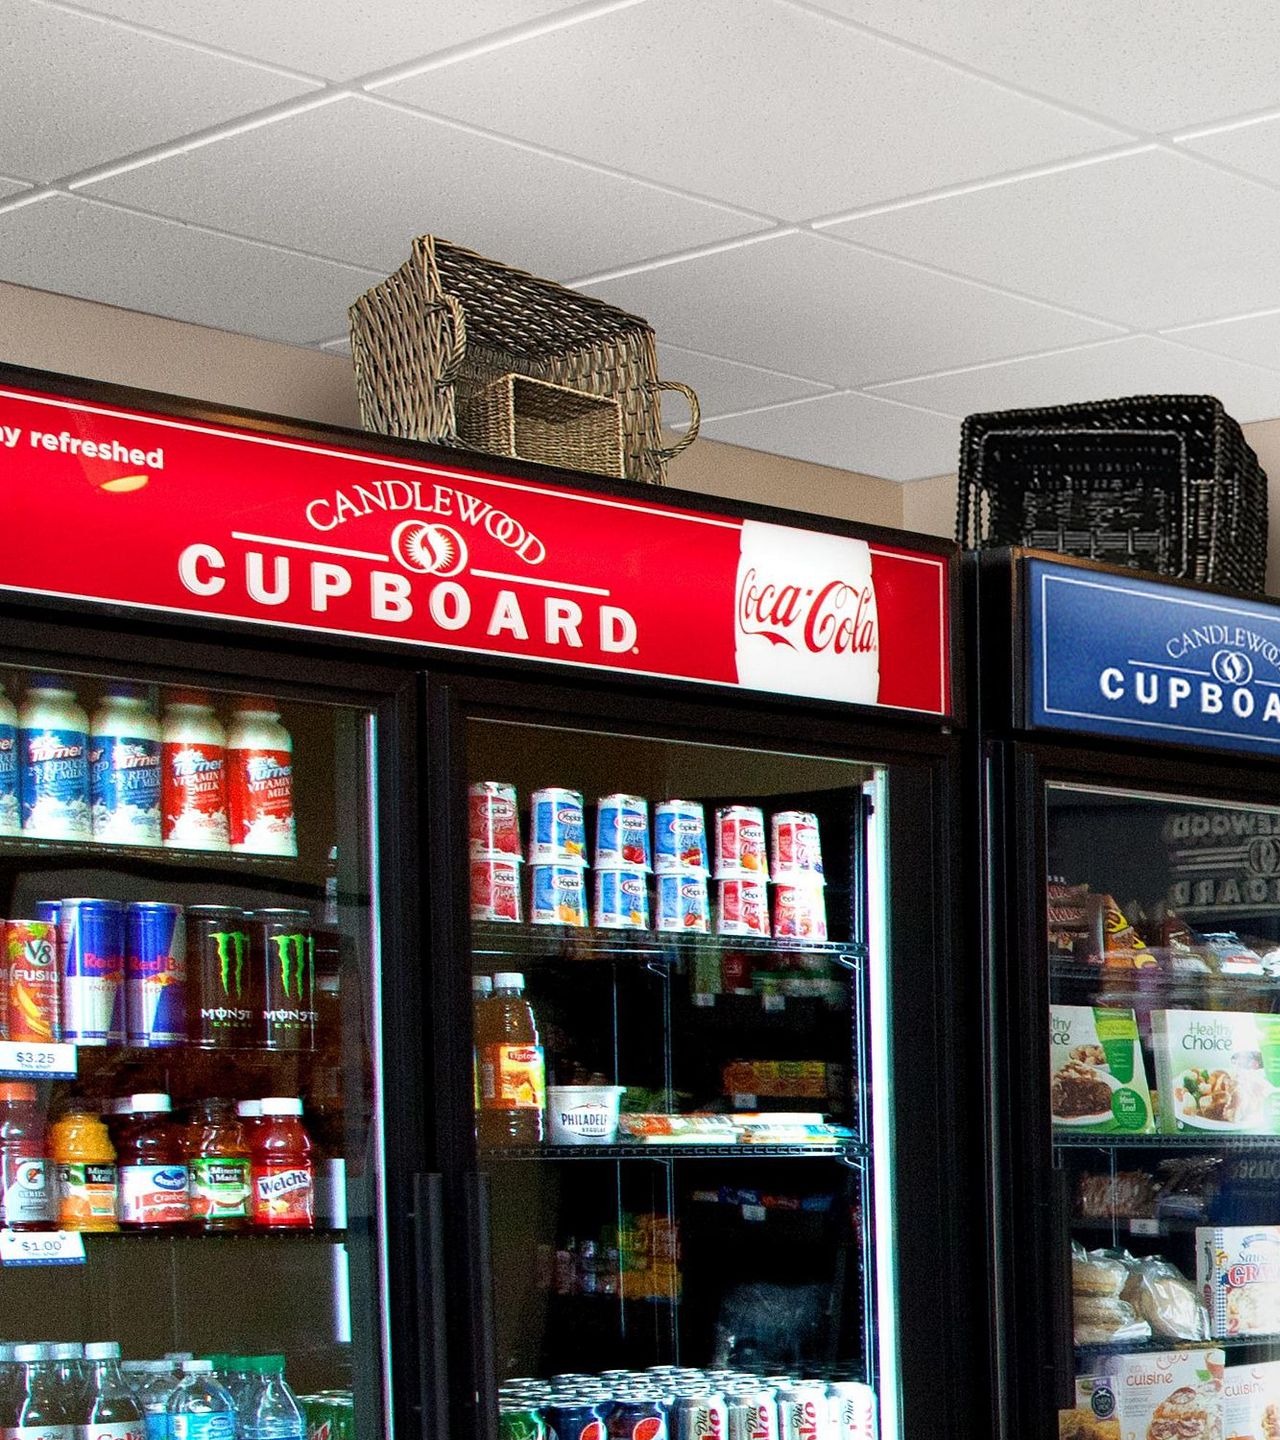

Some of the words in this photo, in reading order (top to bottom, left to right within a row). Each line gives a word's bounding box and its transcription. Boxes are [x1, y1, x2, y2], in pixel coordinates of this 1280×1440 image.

[30, 431, 164, 470] refreshed
[304, 479, 546, 567] CANDLEWOOD
[178, 545, 639, 655] CUPBOARD
[738, 568, 878, 656] Coca-Cola
[22, 1241, 62, 1252] $1.00
[1126, 1370, 1174, 1388] cuisine
